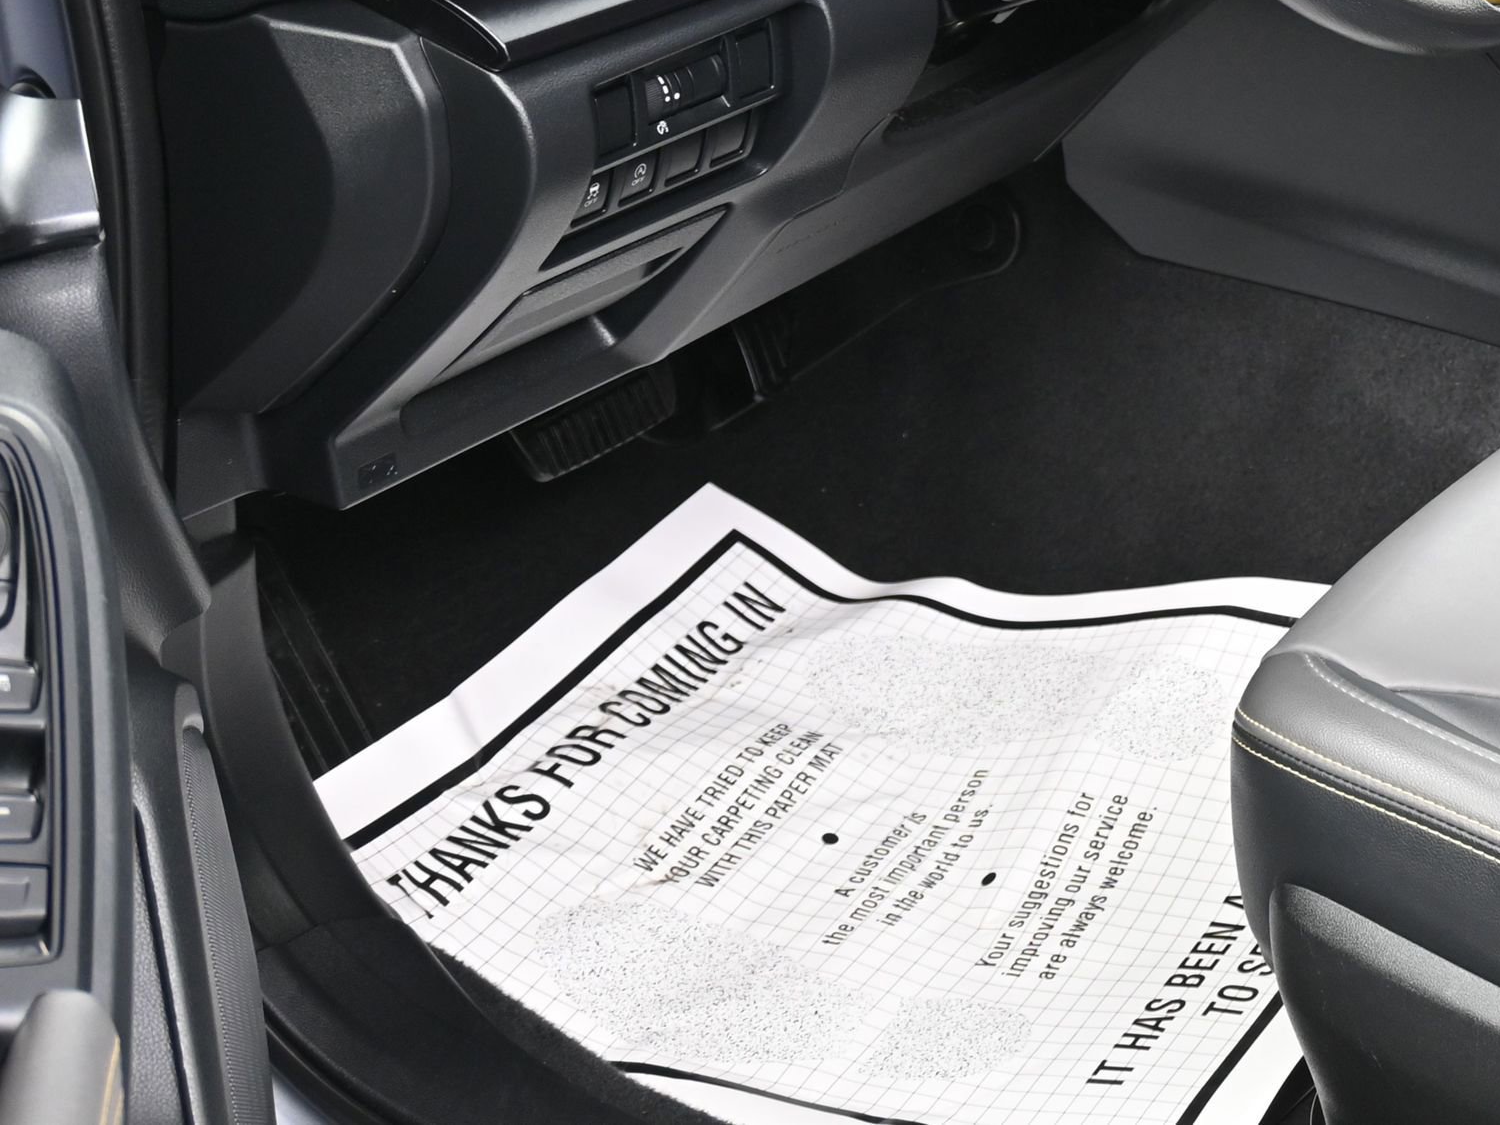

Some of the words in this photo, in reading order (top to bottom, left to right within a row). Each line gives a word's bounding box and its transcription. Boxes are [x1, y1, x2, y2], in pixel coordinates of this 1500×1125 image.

[386, 785, 551, 920] THANKS
[526, 725, 627, 789] FOR
[598, 621, 747, 727] COMING
[723, 581, 786, 631] IN
[634, 845, 668, 872] WE
[659, 806, 706, 848] HAVE
[695, 764, 745, 808] TRIED
[736, 746, 765, 763] TO
[755, 723, 793, 748] KEEP
[662, 845, 710, 884] YOUR
[701, 765, 784, 847] CARPETING
[775, 731, 825, 766] CLEAN
[694, 852, 742, 888] WITH
[730, 819, 774, 851] THIS
[764, 771, 817, 820] PAPER
[807, 742, 844, 773] MAT
[821, 924, 855, 946] the
[850, 886, 891, 922] most
[878, 824, 949, 885] important
[942, 769, 990, 824] person
[834, 887, 856, 898] A
[849, 824, 913, 884] customer
[903, 812, 928, 825] is
[876, 911, 902, 927] in
[892, 889, 925, 912] the
[918, 852, 961, 889] world
[949, 833, 974, 848] to
[968, 804, 994, 828] us.
[974, 932, 1015, 967] Your
[1008, 822, 1080, 928] suggestions
[1066, 791, 1095, 818] for
[1001, 895, 1076, 978] improving
[1064, 865, 1092, 893] our
[1083, 794, 1129, 861] service
[1038, 953, 1068, 980] are
[1059, 894, 1108, 948] always
[1098, 805, 1158, 890] welcome.
[1086, 1059, 1135, 1086] IT
[1113, 998, 1186, 1051] HAS
[1163, 921, 1246, 988] BEEN
[1201, 984, 1260, 1017] TO
